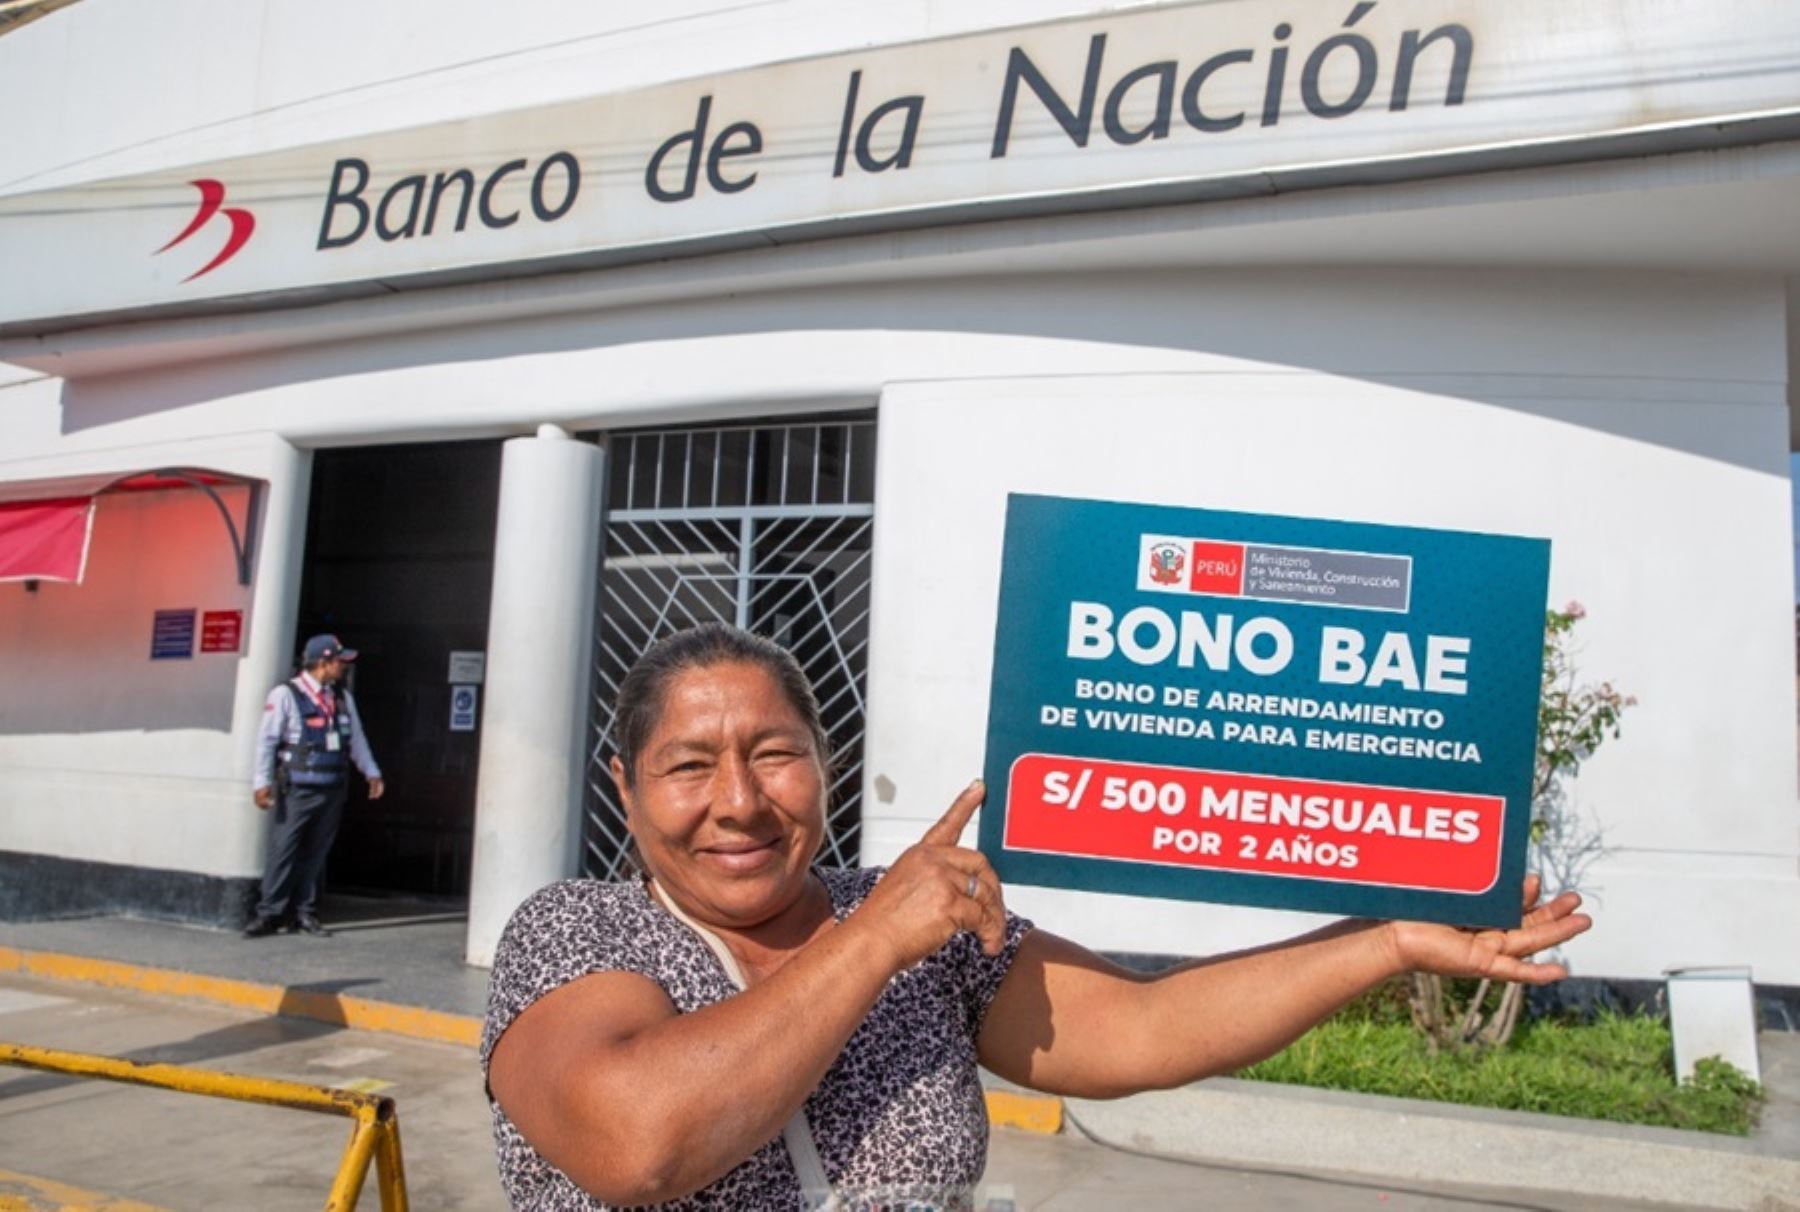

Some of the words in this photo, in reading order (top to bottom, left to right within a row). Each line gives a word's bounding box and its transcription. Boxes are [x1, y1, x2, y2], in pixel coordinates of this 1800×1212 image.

[318, 149, 580, 250] Banco
[645, 95, 762, 202] de
[833, 70, 924, 177] la
[991, 1, 1474, 158] Nación
[1195, 559, 1238, 577] PERÚ
[1249, 565, 1266, 576] de
[1322, 571, 1401, 589] Construcción
[1250, 552, 1311, 569] Ministerio
[1248, 580, 1257, 591] y
[1258, 579, 1337, 595] Saneamiento
[1066, 600, 1295, 676] BONO
[1319, 626, 1472, 695] BAE
[1075, 678, 1156, 705] BONO
[1163, 687, 1200, 709] DE
[1206, 690, 1445, 730] ARRENDAMIENTO
[1041, 704, 1078, 728] DE
[1085, 709, 1216, 740] VIVIENDA
[1222, 721, 1297, 747] PARA
[1305, 728, 1482, 763] EMERGENCIA
[1042, 769, 1093, 811] S/
[1101, 777, 1187, 816] 500
[1200, 785, 1481, 844] MENSUALES
[1152, 826, 1223, 856] POR
[1239, 834, 1258, 859] 2
[1265, 833, 1360, 869] AÑOS
